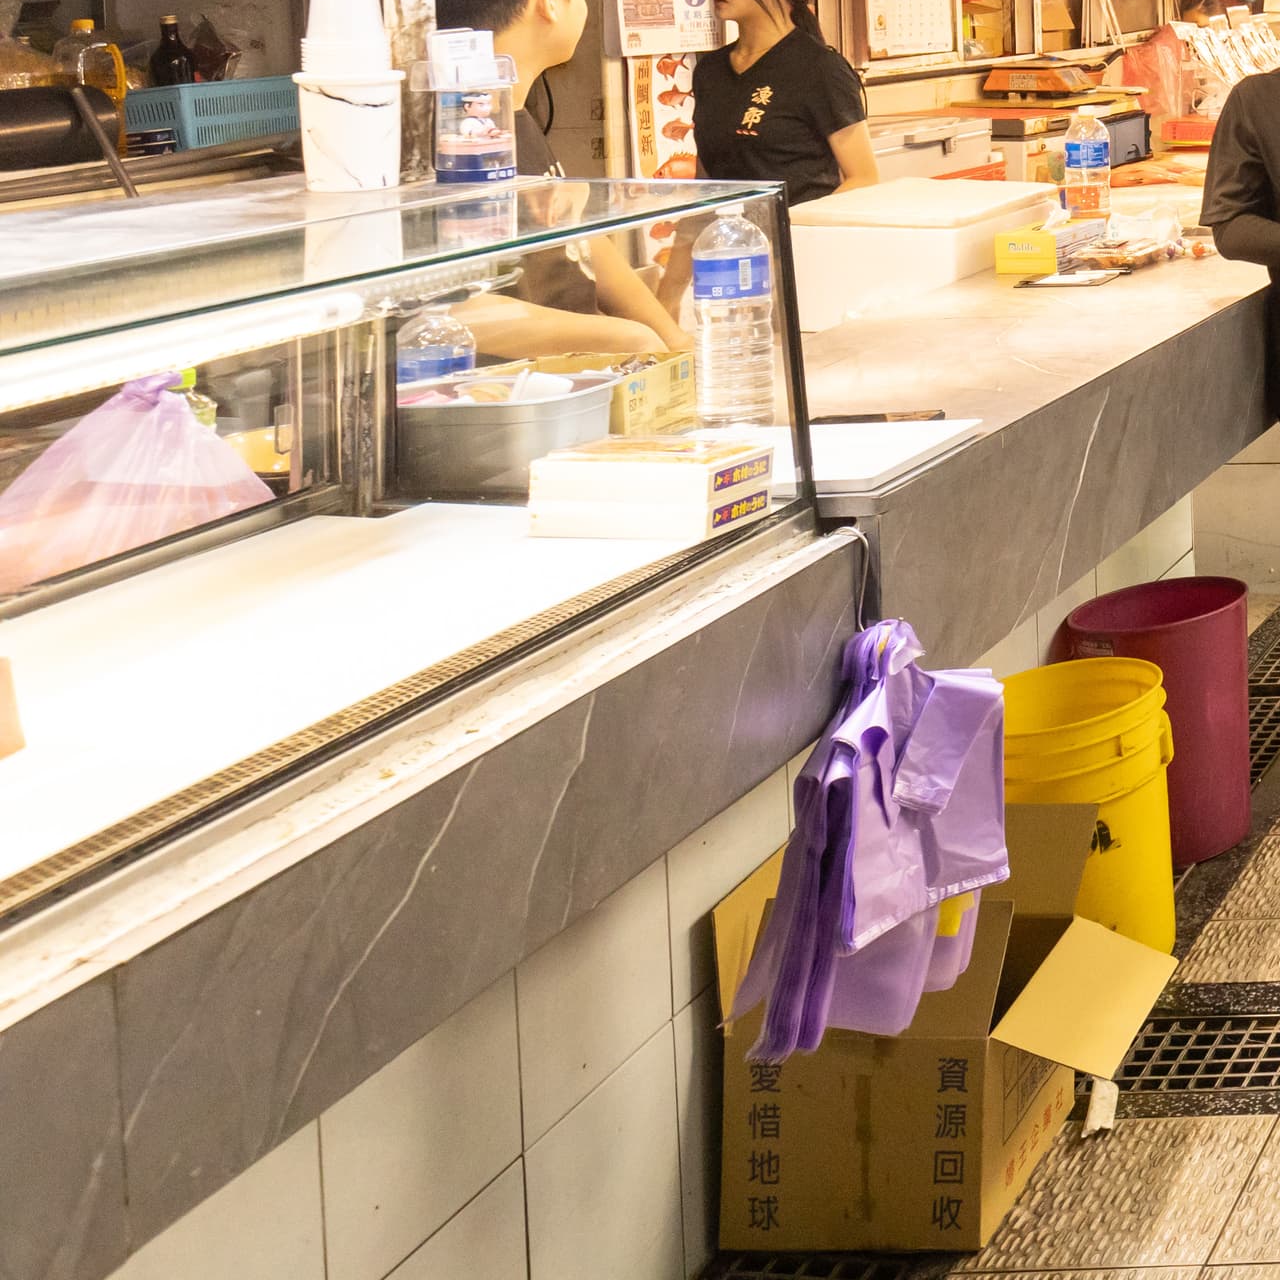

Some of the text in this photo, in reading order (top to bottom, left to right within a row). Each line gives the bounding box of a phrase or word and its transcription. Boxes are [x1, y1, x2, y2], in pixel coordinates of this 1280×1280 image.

[748, 1060, 782, 1231] 愛惜地球
[932, 1057, 969, 1232] 資源回收
